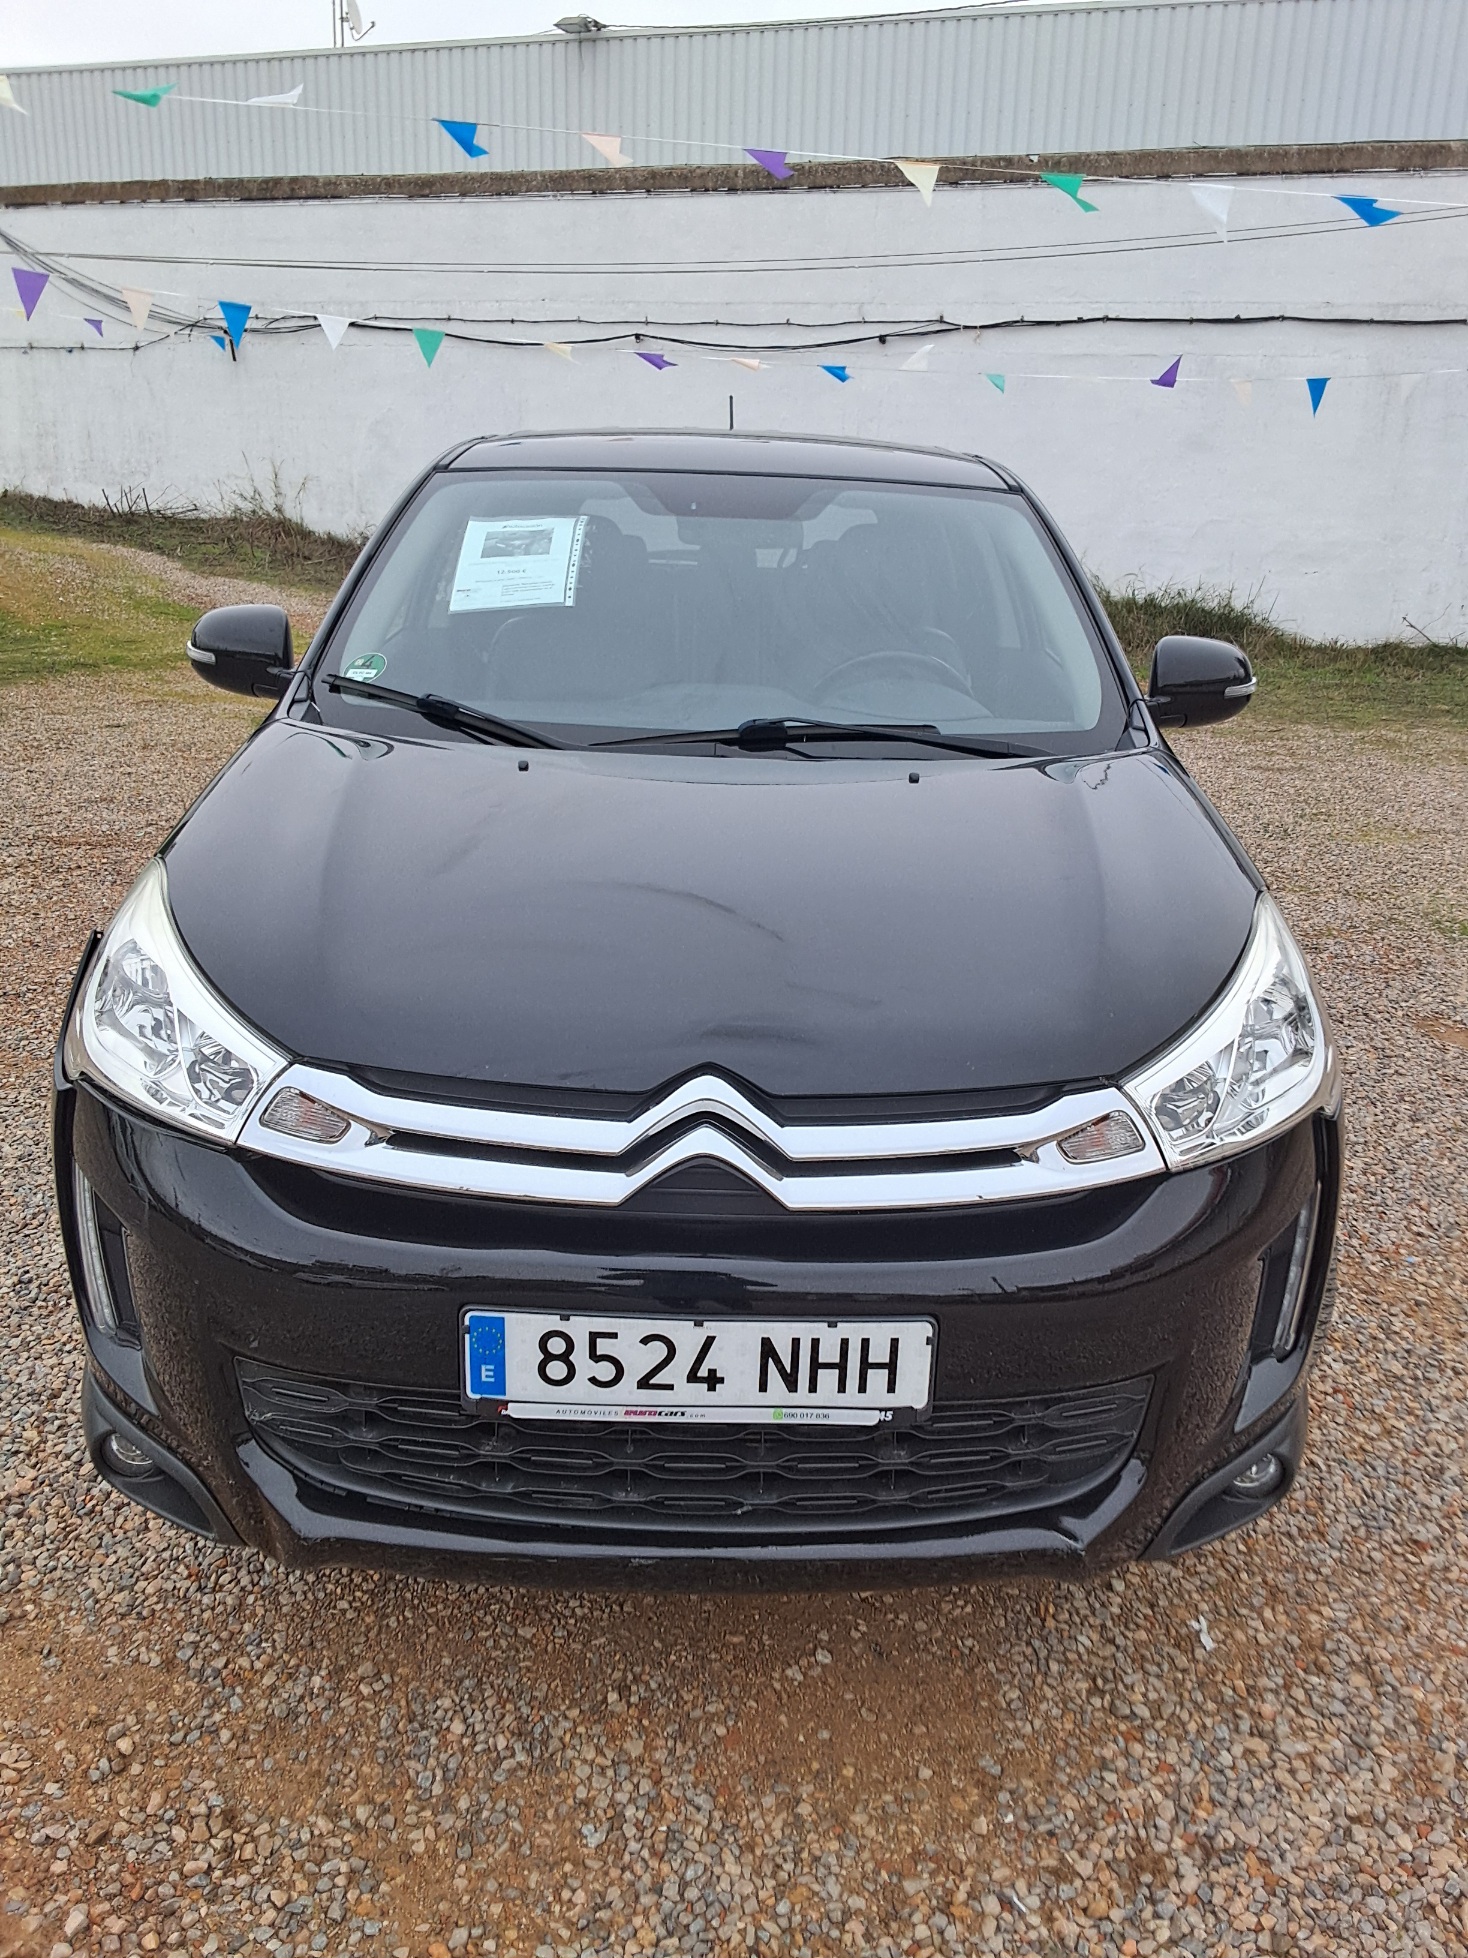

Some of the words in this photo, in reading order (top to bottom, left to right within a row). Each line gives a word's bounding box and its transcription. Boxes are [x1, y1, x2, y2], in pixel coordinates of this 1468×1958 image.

[480, 1365, 495, 1382] E
[537, 1330, 725, 1391] 8524
[759, 1337, 900, 1393] NHH
